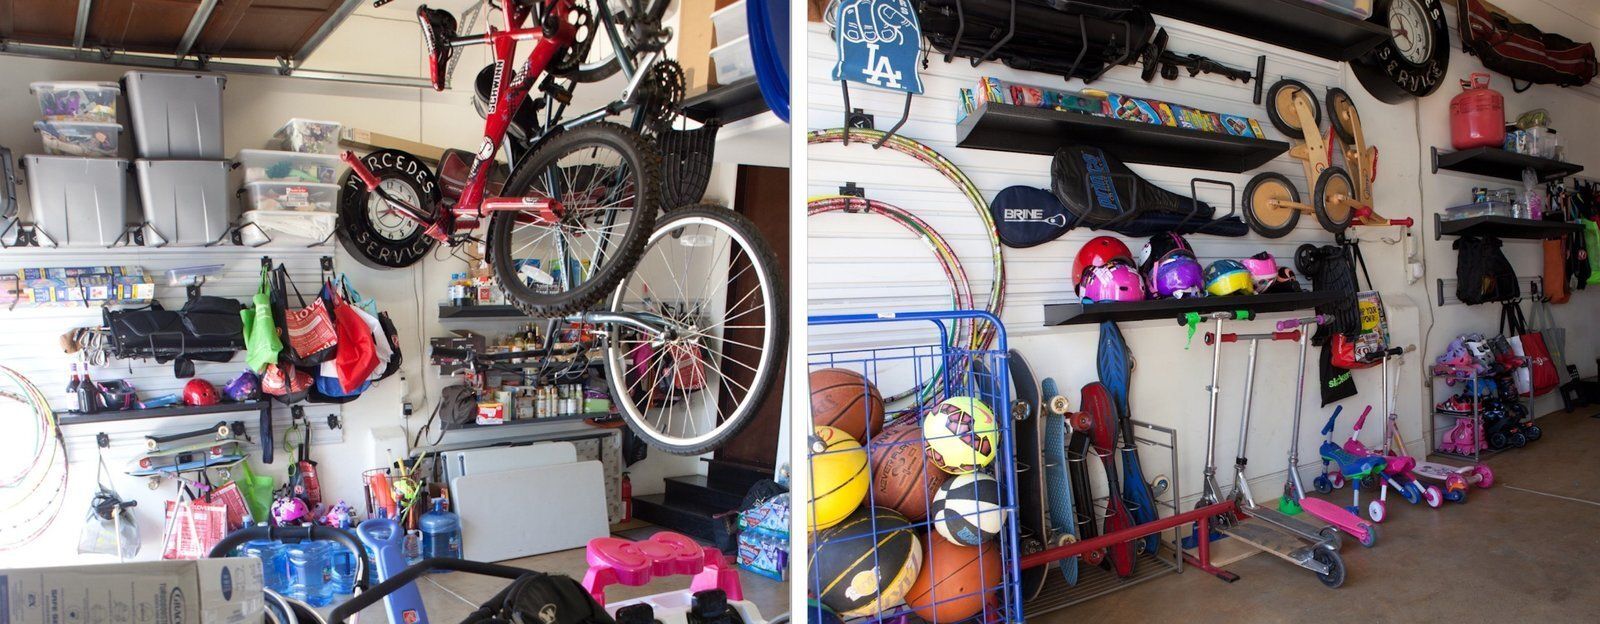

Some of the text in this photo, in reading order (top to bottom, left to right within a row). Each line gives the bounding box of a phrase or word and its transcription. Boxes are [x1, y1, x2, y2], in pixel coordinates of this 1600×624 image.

[488, 60, 504, 114] SCHWINN
[862, 43, 902, 89] LA
[1379, 47, 1442, 92] SERVICE
[347, 152, 434, 194] MRCEDES
[1004, 208, 1043, 219] BRINE
